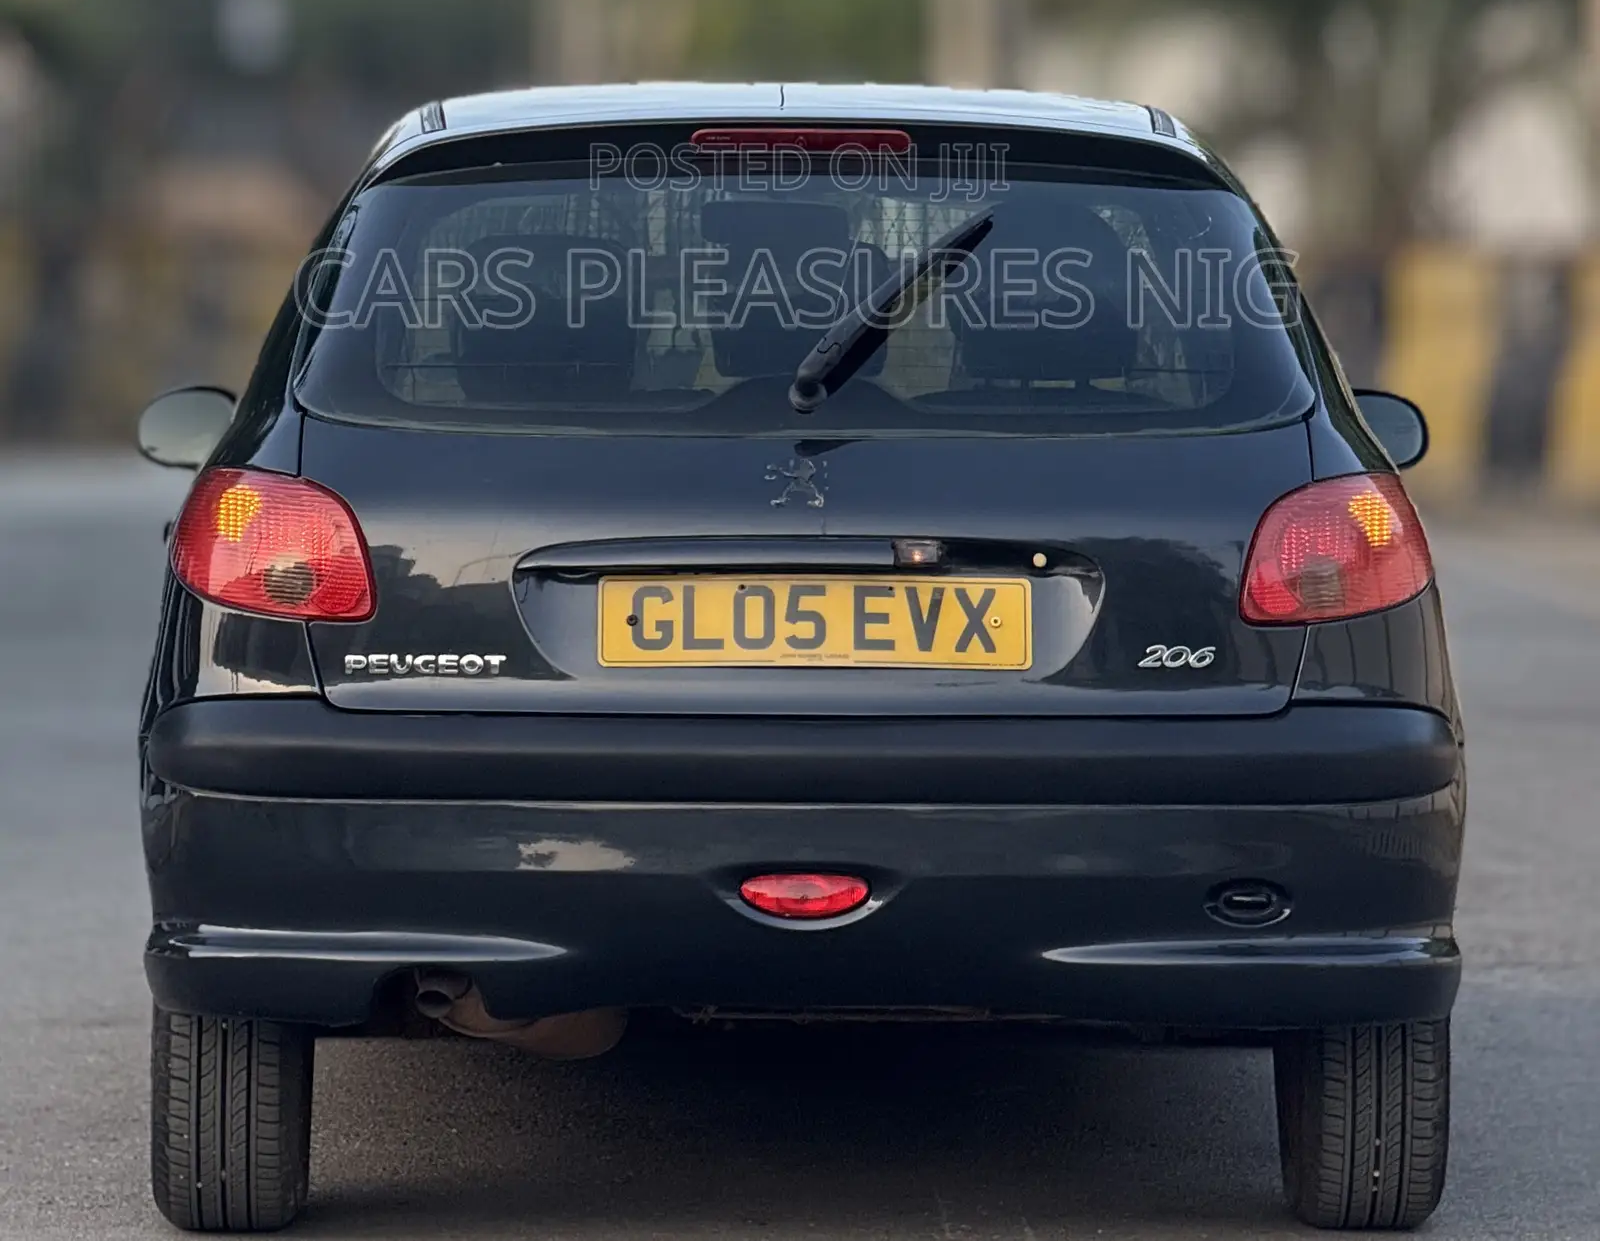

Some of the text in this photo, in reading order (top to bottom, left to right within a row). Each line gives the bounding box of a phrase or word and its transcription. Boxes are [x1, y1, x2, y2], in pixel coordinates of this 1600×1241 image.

[630, 584, 997, 654] GL05 EVX
[344, 654, 508, 675] PEUGEOT
[1137, 644, 1216, 668] 206
